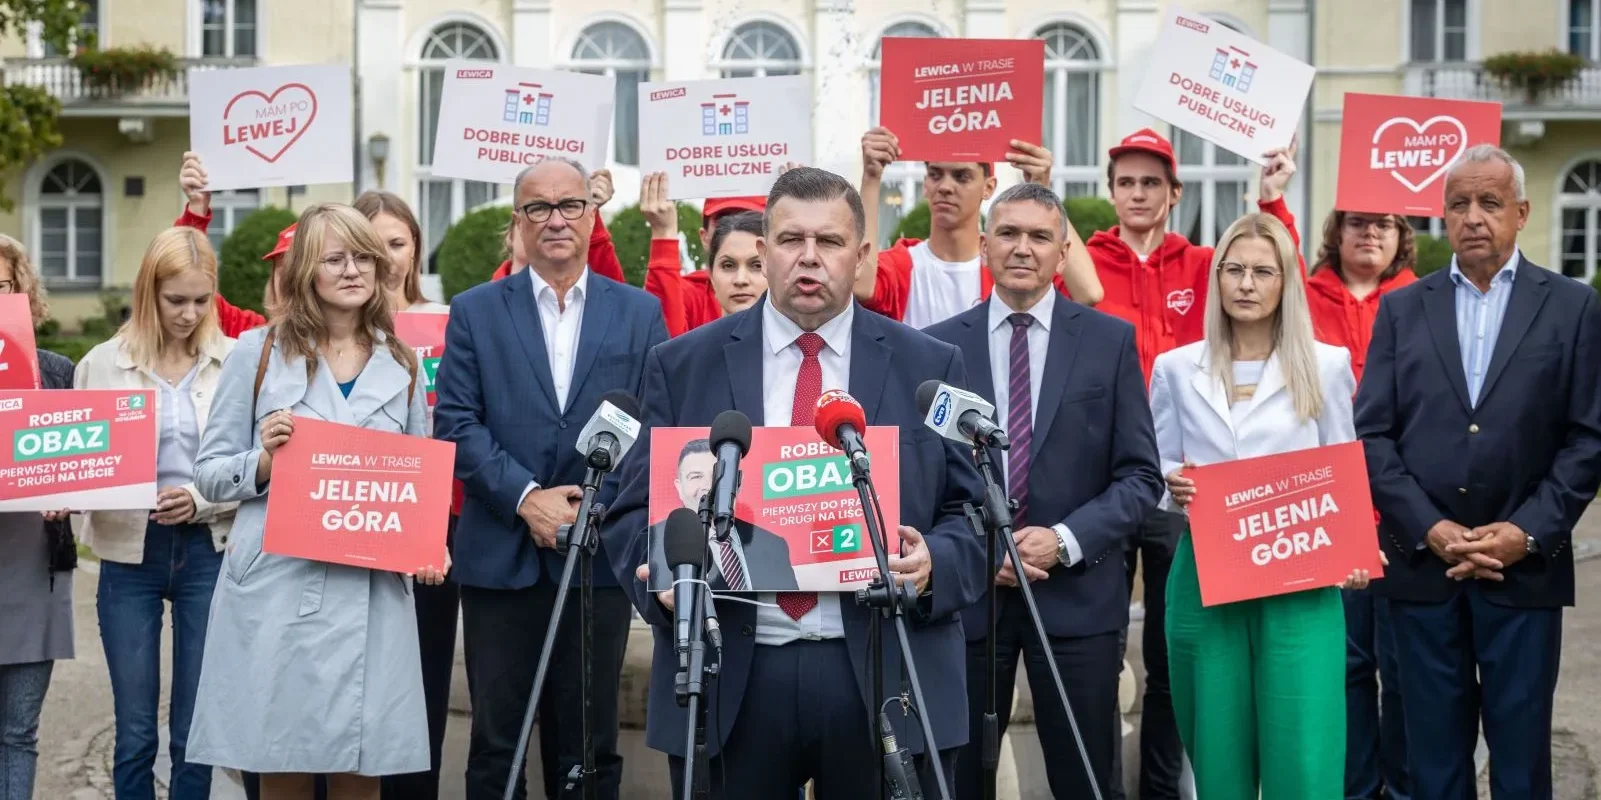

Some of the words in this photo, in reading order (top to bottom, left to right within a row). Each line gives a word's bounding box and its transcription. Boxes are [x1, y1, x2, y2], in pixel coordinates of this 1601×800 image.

[457, 70, 492, 79] LEWICA
[914, 64, 959, 77] LEWICA
[962, 62, 975, 73] W
[978, 57, 1015, 71] TRASIE
[651, 88, 686, 101] LEWICA
[916, 81, 1013, 109] JELENIA
[1169, 72, 1221, 103] DOBRE
[1222, 96, 1276, 129] USŁUGI
[255, 104, 287, 119] MAM
[290, 100, 309, 112] PO
[1177, 94, 1257, 139] PUBLICZNE
[223, 117, 297, 146] LEWEJ
[928, 107, 1001, 135] GÓRA
[463, 127, 521, 146] DOBRE
[524, 135, 585, 154] USŁUGI
[1404, 134, 1437, 148] MAM
[1439, 133, 1458, 146] PO
[477, 147, 546, 167] PUBLICZ
[665, 146, 723, 161] DOBRE
[727, 143, 788, 158] USŁUGI
[1370, 147, 1446, 170] LEWEJ
[682, 161, 773, 178] PUBLICZNE
[133, 396, 142, 408] 2
[29, 408, 94, 427] ROBERT
[17, 425, 104, 457] OBAZ
[780, 441, 840, 459] ROBE
[0, 463, 58, 479] PIERWSZY
[60, 460, 79, 472] DO
[81, 455, 122, 470] PRACY
[311, 453, 361, 466] LEWICA
[365, 456, 377, 467] W
[382, 456, 422, 468] TRASIE
[18, 475, 55, 488] DRUGI
[58, 472, 76, 483] NA
[78, 466, 114, 480] LIŚCIE
[1224, 484, 1274, 507] LEWICA
[1276, 479, 1289, 492] W
[1292, 466, 1333, 487] TRASIE
[310, 479, 418, 503] JELENIA
[322, 504, 402, 533] GÓRA
[762, 503, 818, 517] PIERWSZY
[820, 501, 838, 510] DO
[779, 513, 816, 527] DRUGI
[818, 512, 836, 522] NA
[838, 506, 863, 519] LIŚC
[1232, 493, 1339, 541] JELENIA
[840, 528, 855, 548] 2
[1251, 526, 1332, 566] GÓRA
[842, 568, 879, 581] LEWIC
